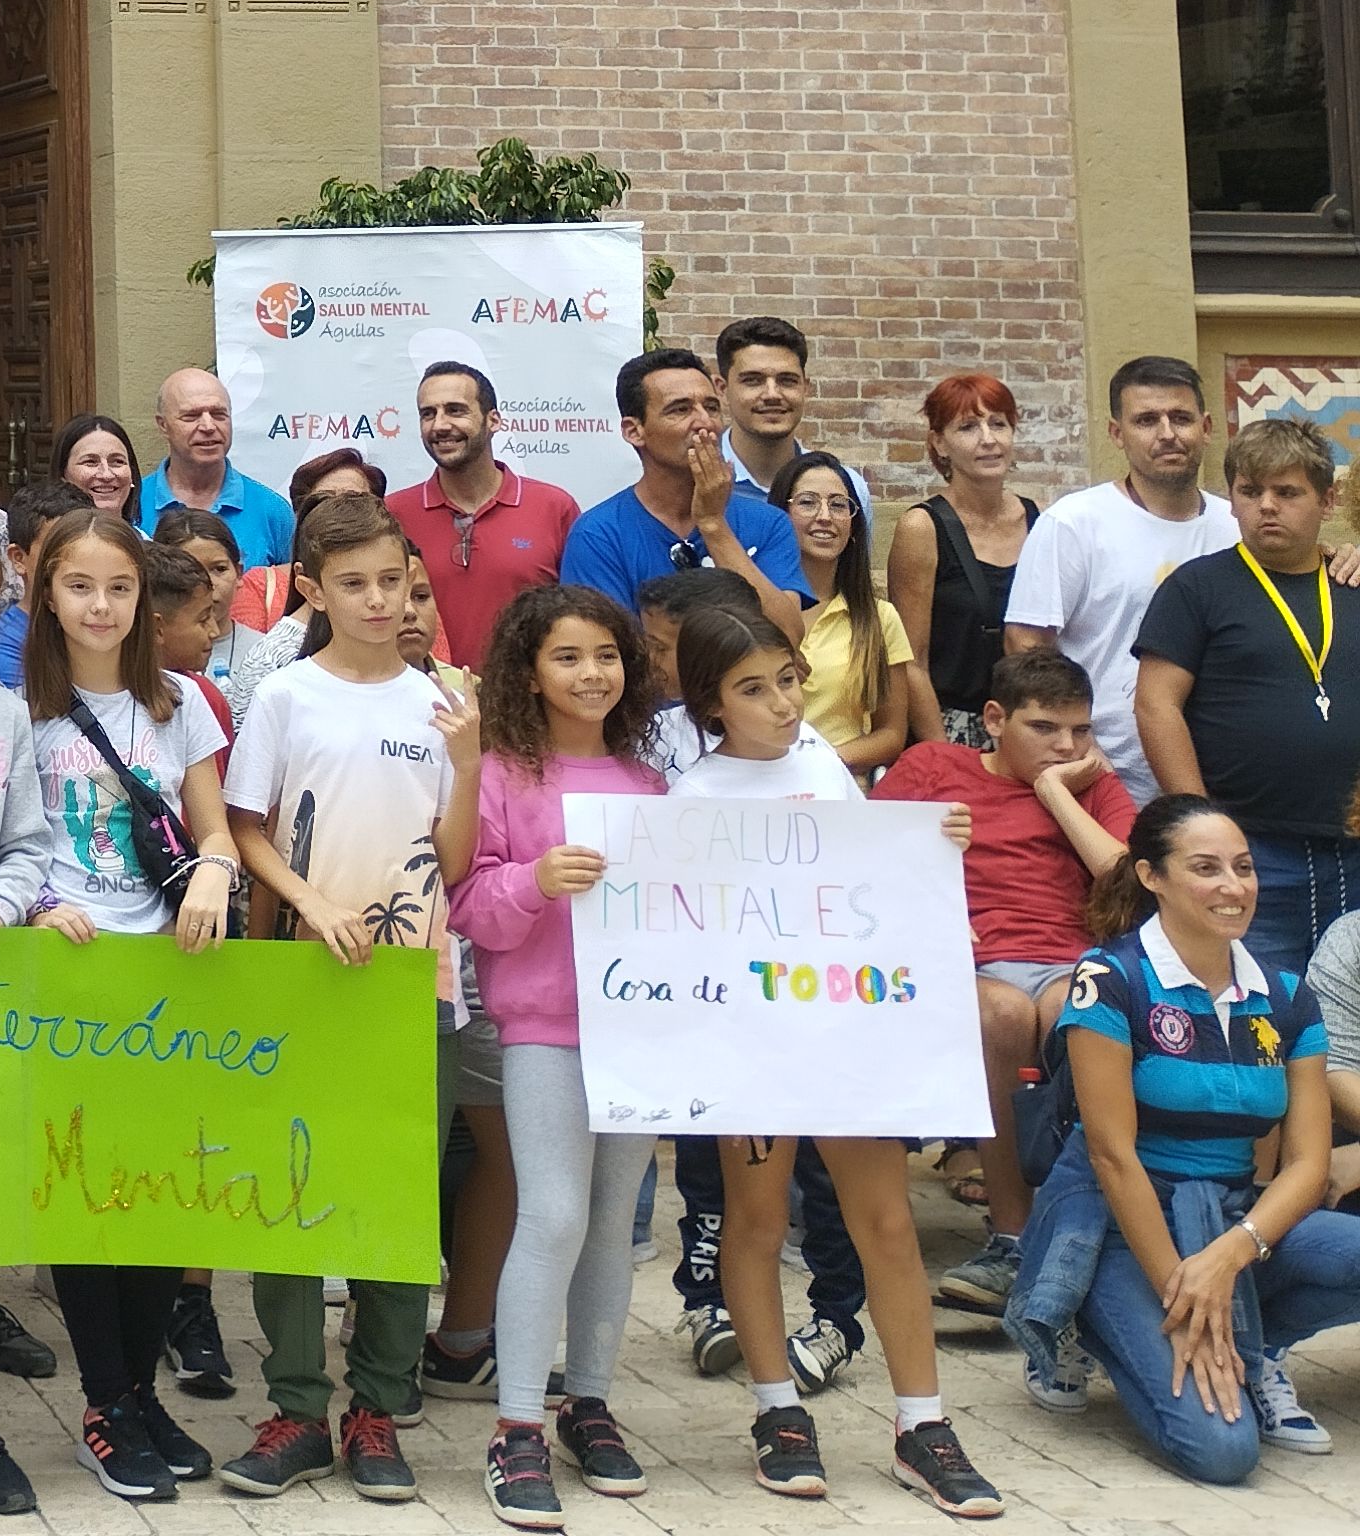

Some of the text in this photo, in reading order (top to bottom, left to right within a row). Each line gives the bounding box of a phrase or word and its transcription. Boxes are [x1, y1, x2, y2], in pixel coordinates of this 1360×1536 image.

[318, 282, 402, 299] asociación
[318, 302, 430, 317] SALUD MENTAL
[471, 287, 610, 325] AFEMAC
[318, 322, 386, 342] Águilas
[499, 397, 586, 413] asociación
[267, 405, 401, 441] AFEMAC
[499, 417, 614, 433] SALUD MENTAL
[500, 438, 571, 457] Águilas
[380, 738, 434, 765] NASA
[601, 801, 820, 866] LA SALUD
[602, 880, 880, 942] MENTAL ES
[602, 957, 917, 1005] Cosa de TODOS
[32, 1103, 337, 1231] Mental
